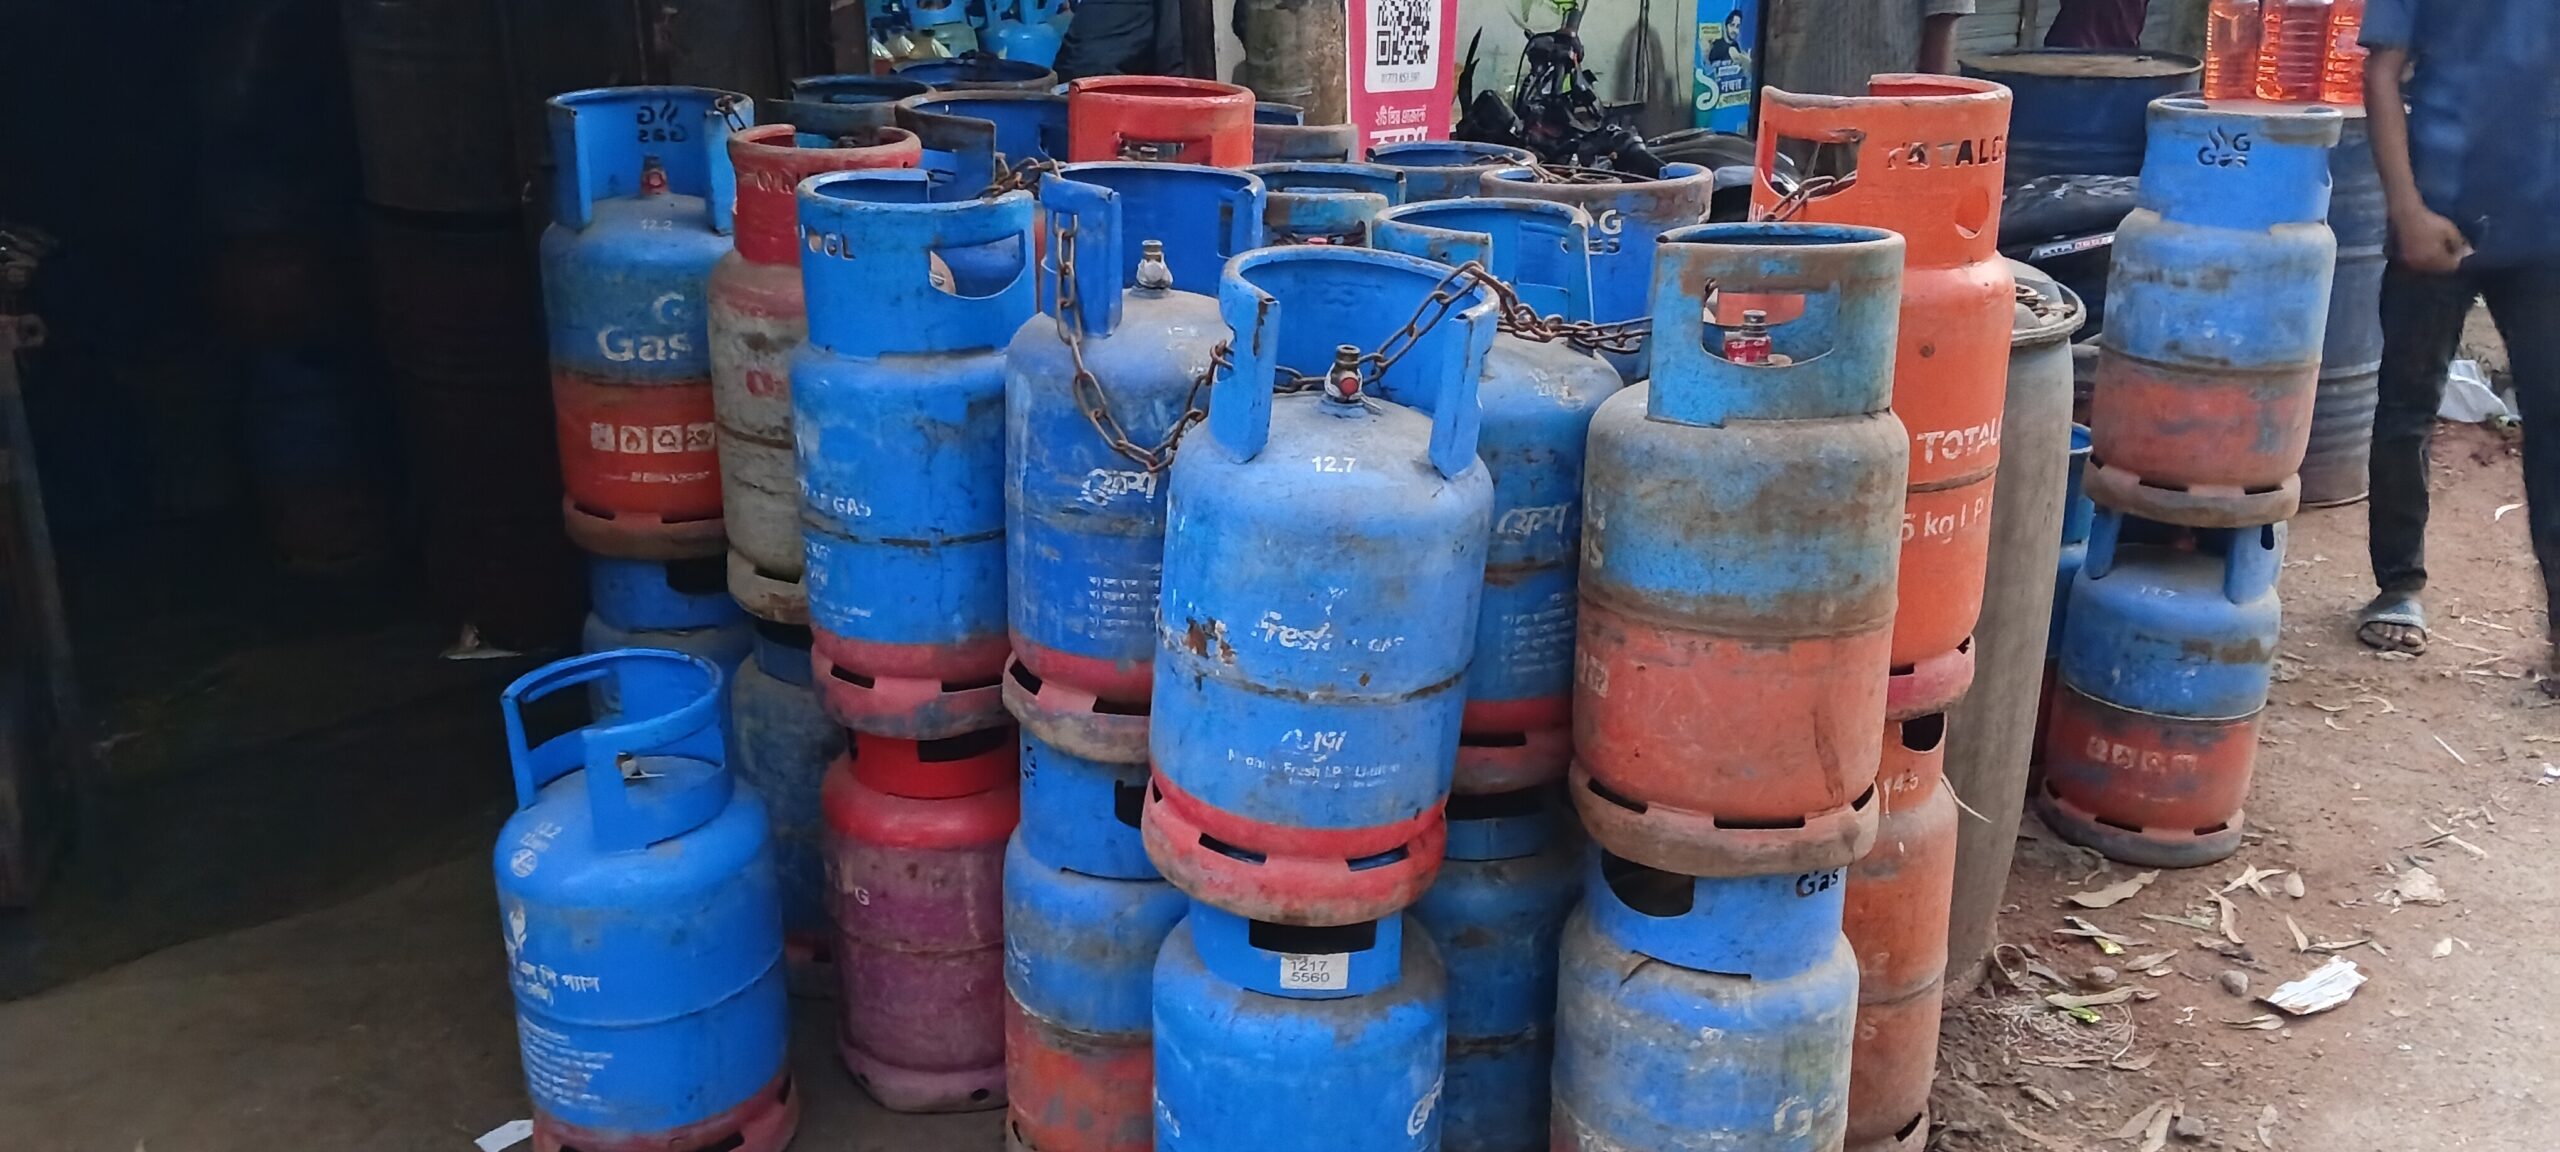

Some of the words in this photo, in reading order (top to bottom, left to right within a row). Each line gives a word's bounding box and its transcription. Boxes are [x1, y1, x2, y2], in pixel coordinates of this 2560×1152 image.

[597, 325, 693, 362] Gas
[1312, 456, 1357, 473] 12.7
[1923, 511, 1956, 544] kg
[1796, 868, 1839, 897] Gas
[1290, 972, 1330, 983] 5560
[1291, 960, 1328, 972] 1217
